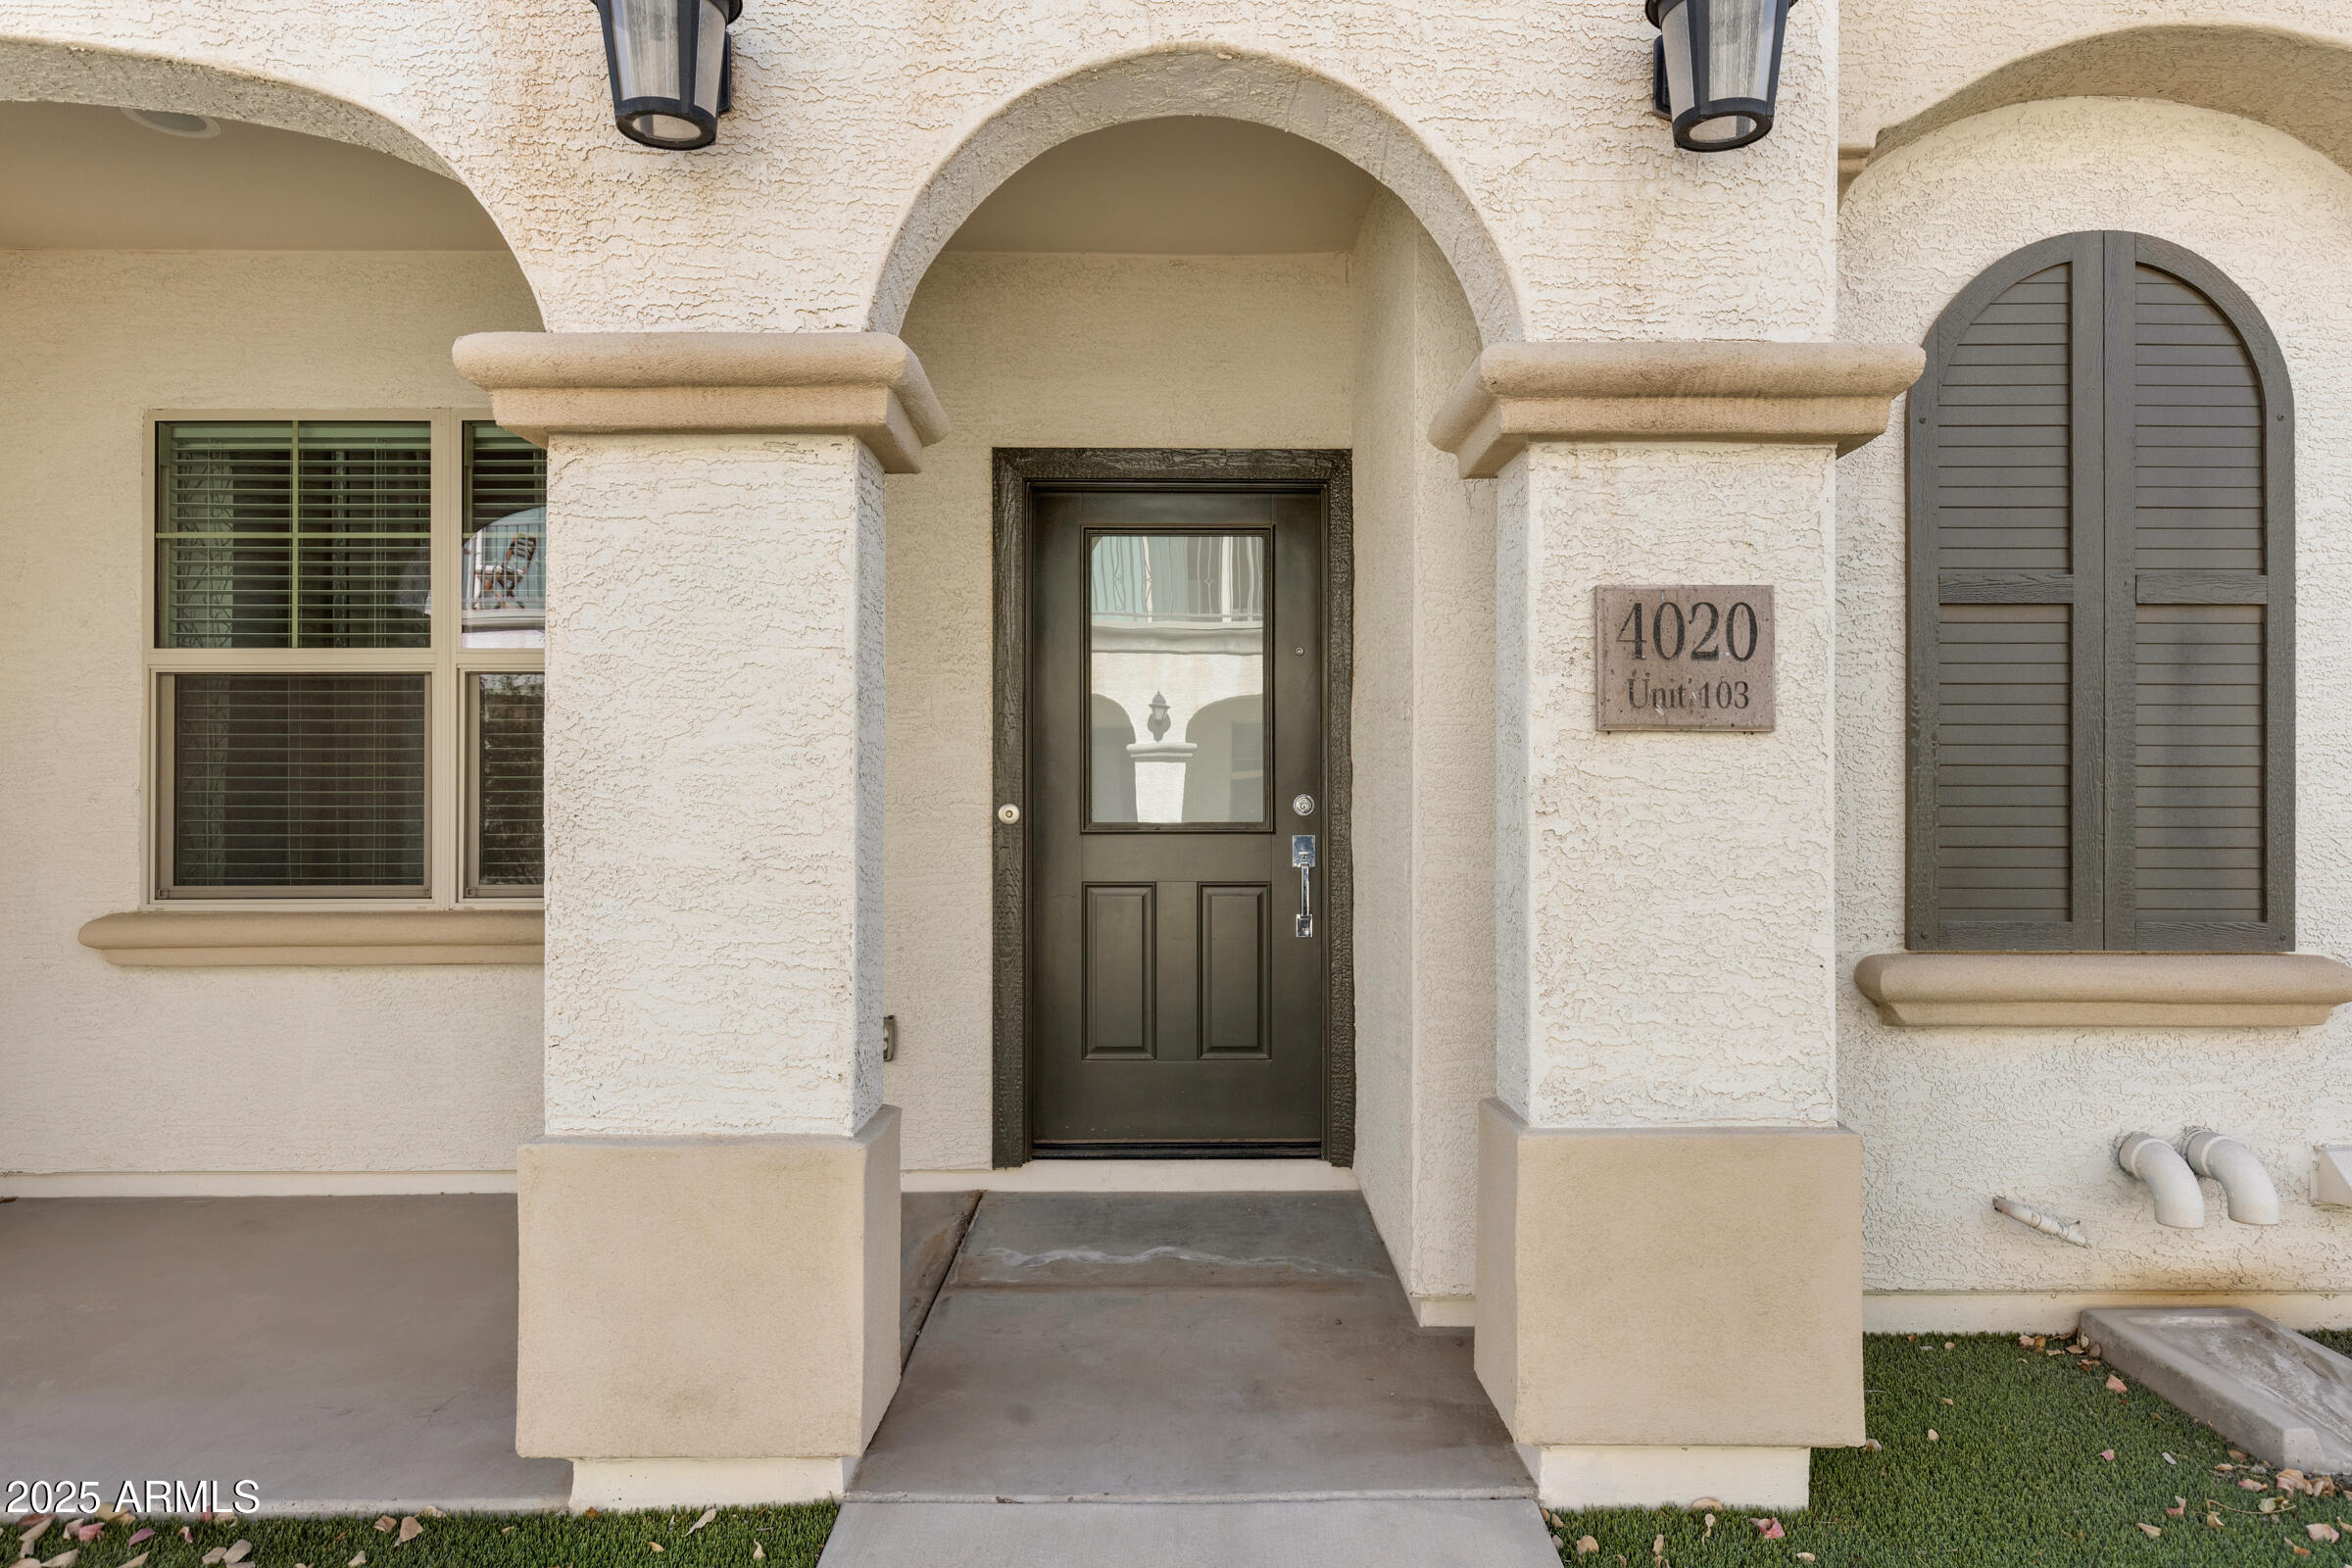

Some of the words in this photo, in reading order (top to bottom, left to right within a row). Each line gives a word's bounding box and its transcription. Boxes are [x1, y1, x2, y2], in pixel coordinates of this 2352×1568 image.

[1616, 602, 1758, 662] 4020
[1626, 678, 1687, 710] Unit
[1699, 680, 1749, 710] 103
